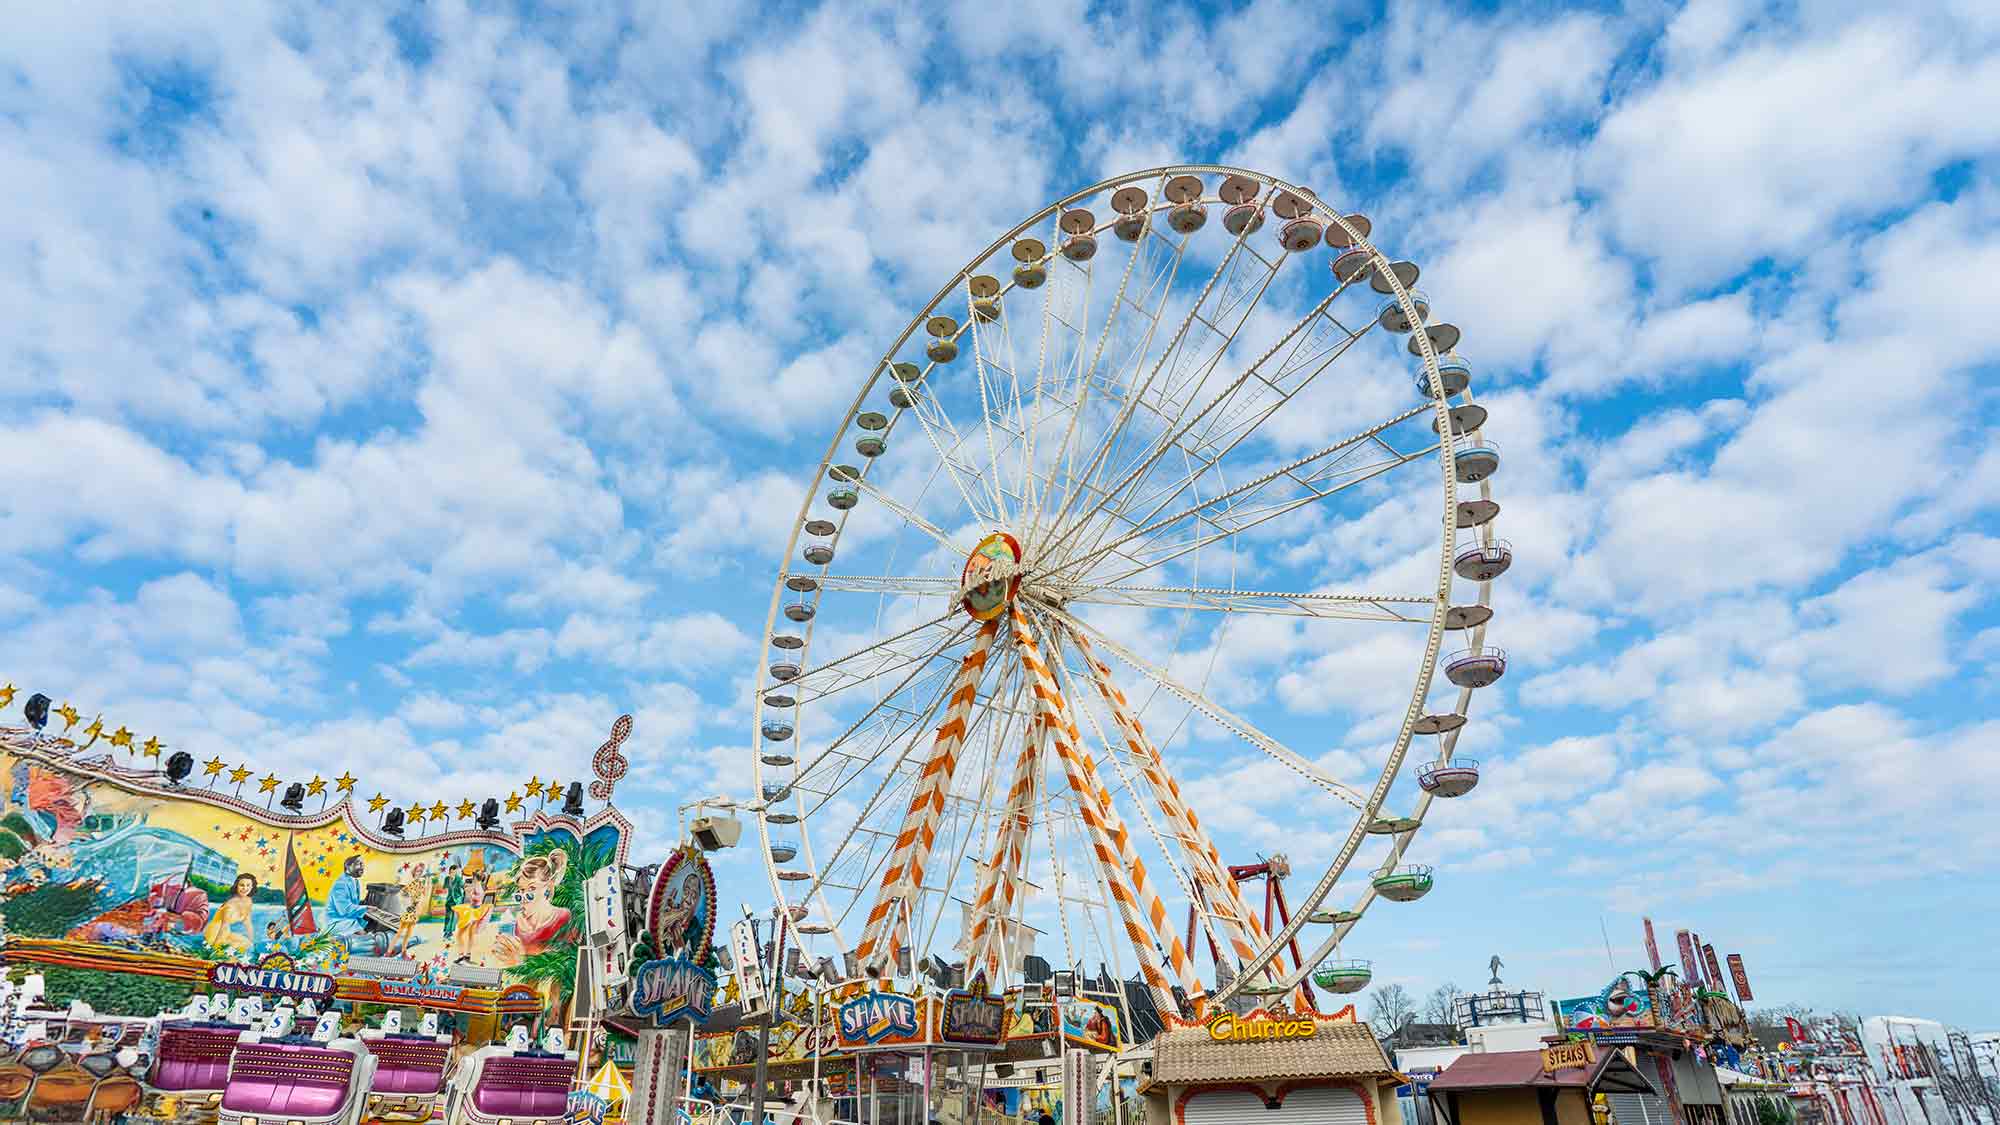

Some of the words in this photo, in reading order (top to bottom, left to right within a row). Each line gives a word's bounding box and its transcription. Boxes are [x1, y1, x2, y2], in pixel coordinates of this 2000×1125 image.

[214, 965, 284, 989] SUNSET
[280, 972, 332, 993] STRIP
[639, 965, 714, 1016] SHAKE
[844, 998, 914, 1034] SHAKE
[1210, 1014, 1315, 1040] Churros
[1549, 1047, 1584, 1065] STEAKS
